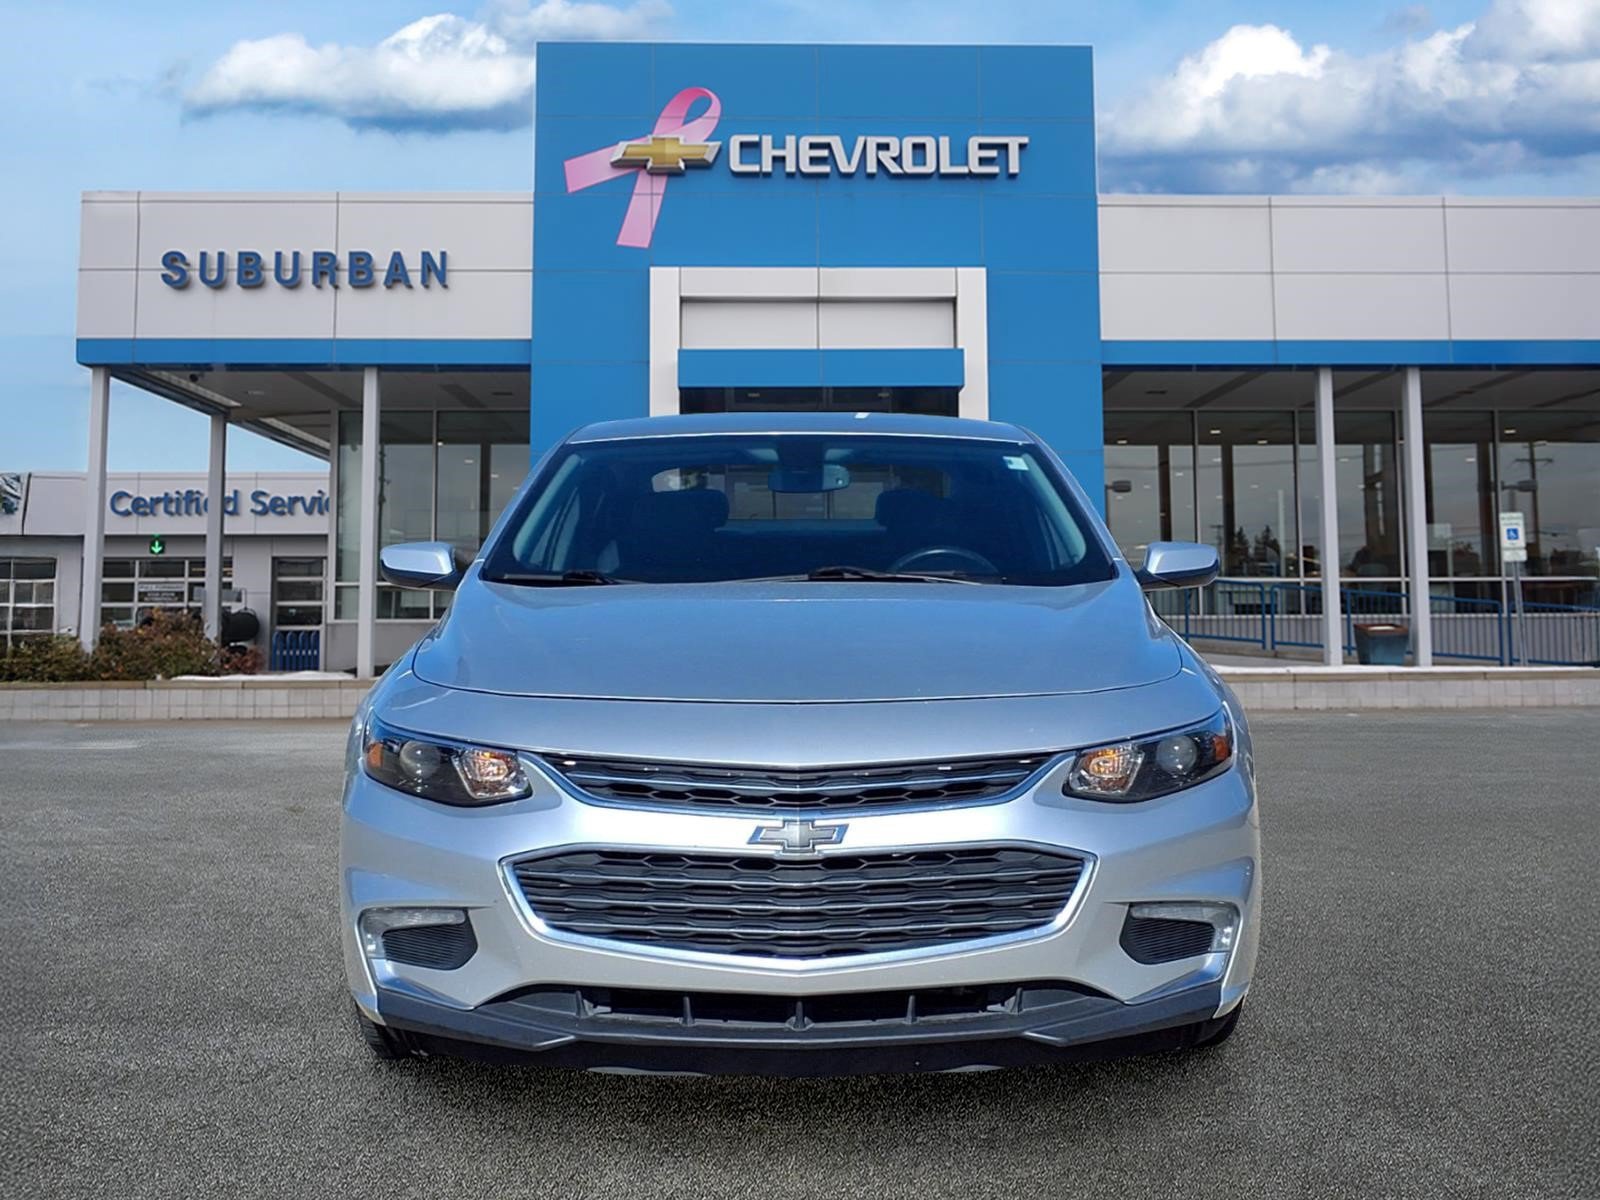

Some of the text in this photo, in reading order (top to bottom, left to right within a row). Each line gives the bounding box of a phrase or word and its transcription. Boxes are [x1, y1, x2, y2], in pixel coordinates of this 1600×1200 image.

[729, 134, 1030, 175] CHEVROLET
[160, 250, 449, 289] SUBURBAN
[109, 489, 240, 517] Certifid
